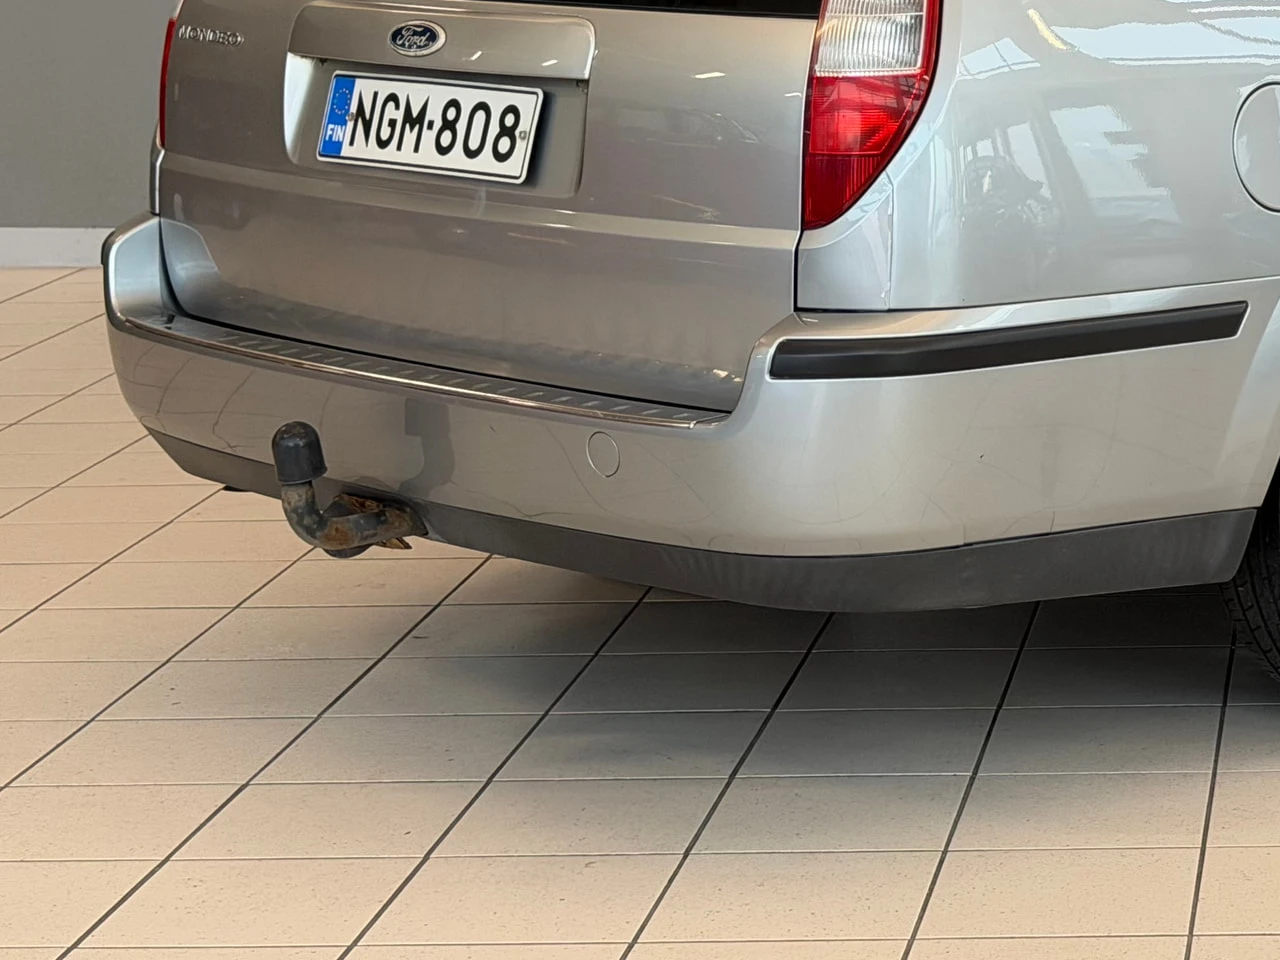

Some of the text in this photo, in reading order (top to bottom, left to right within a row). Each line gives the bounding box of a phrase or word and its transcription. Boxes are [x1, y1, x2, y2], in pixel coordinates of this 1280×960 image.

[396, 25, 430, 49] Ford
[325, 123, 346, 142] FIN
[348, 89, 521, 163] NGM-808
